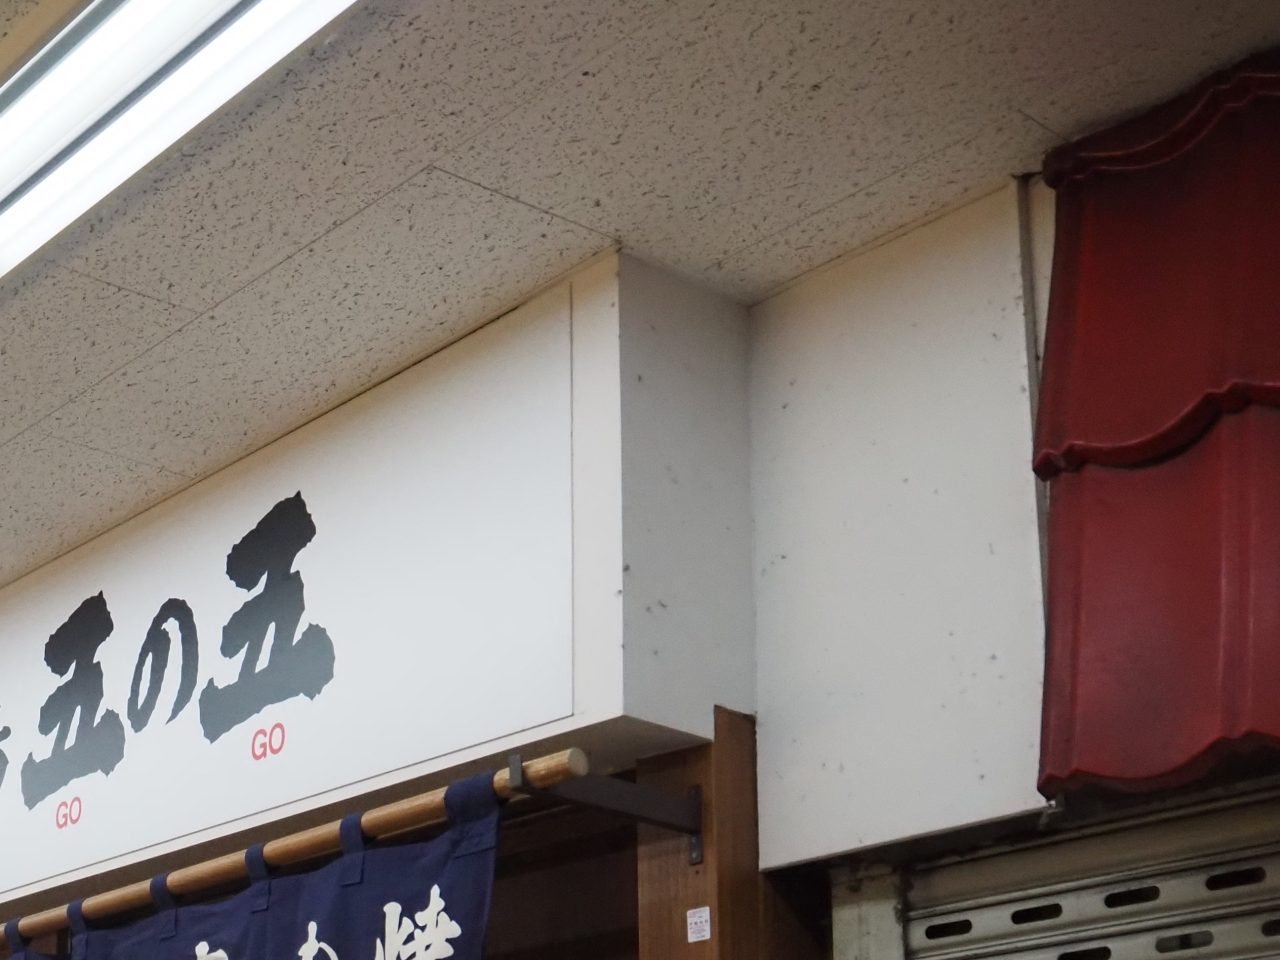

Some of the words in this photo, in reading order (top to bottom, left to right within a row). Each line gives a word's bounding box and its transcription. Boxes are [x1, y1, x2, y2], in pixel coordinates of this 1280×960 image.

[20, 490, 336, 811] 五の五
[250, 722, 286, 762] GO
[55, 796, 83, 830] GO
